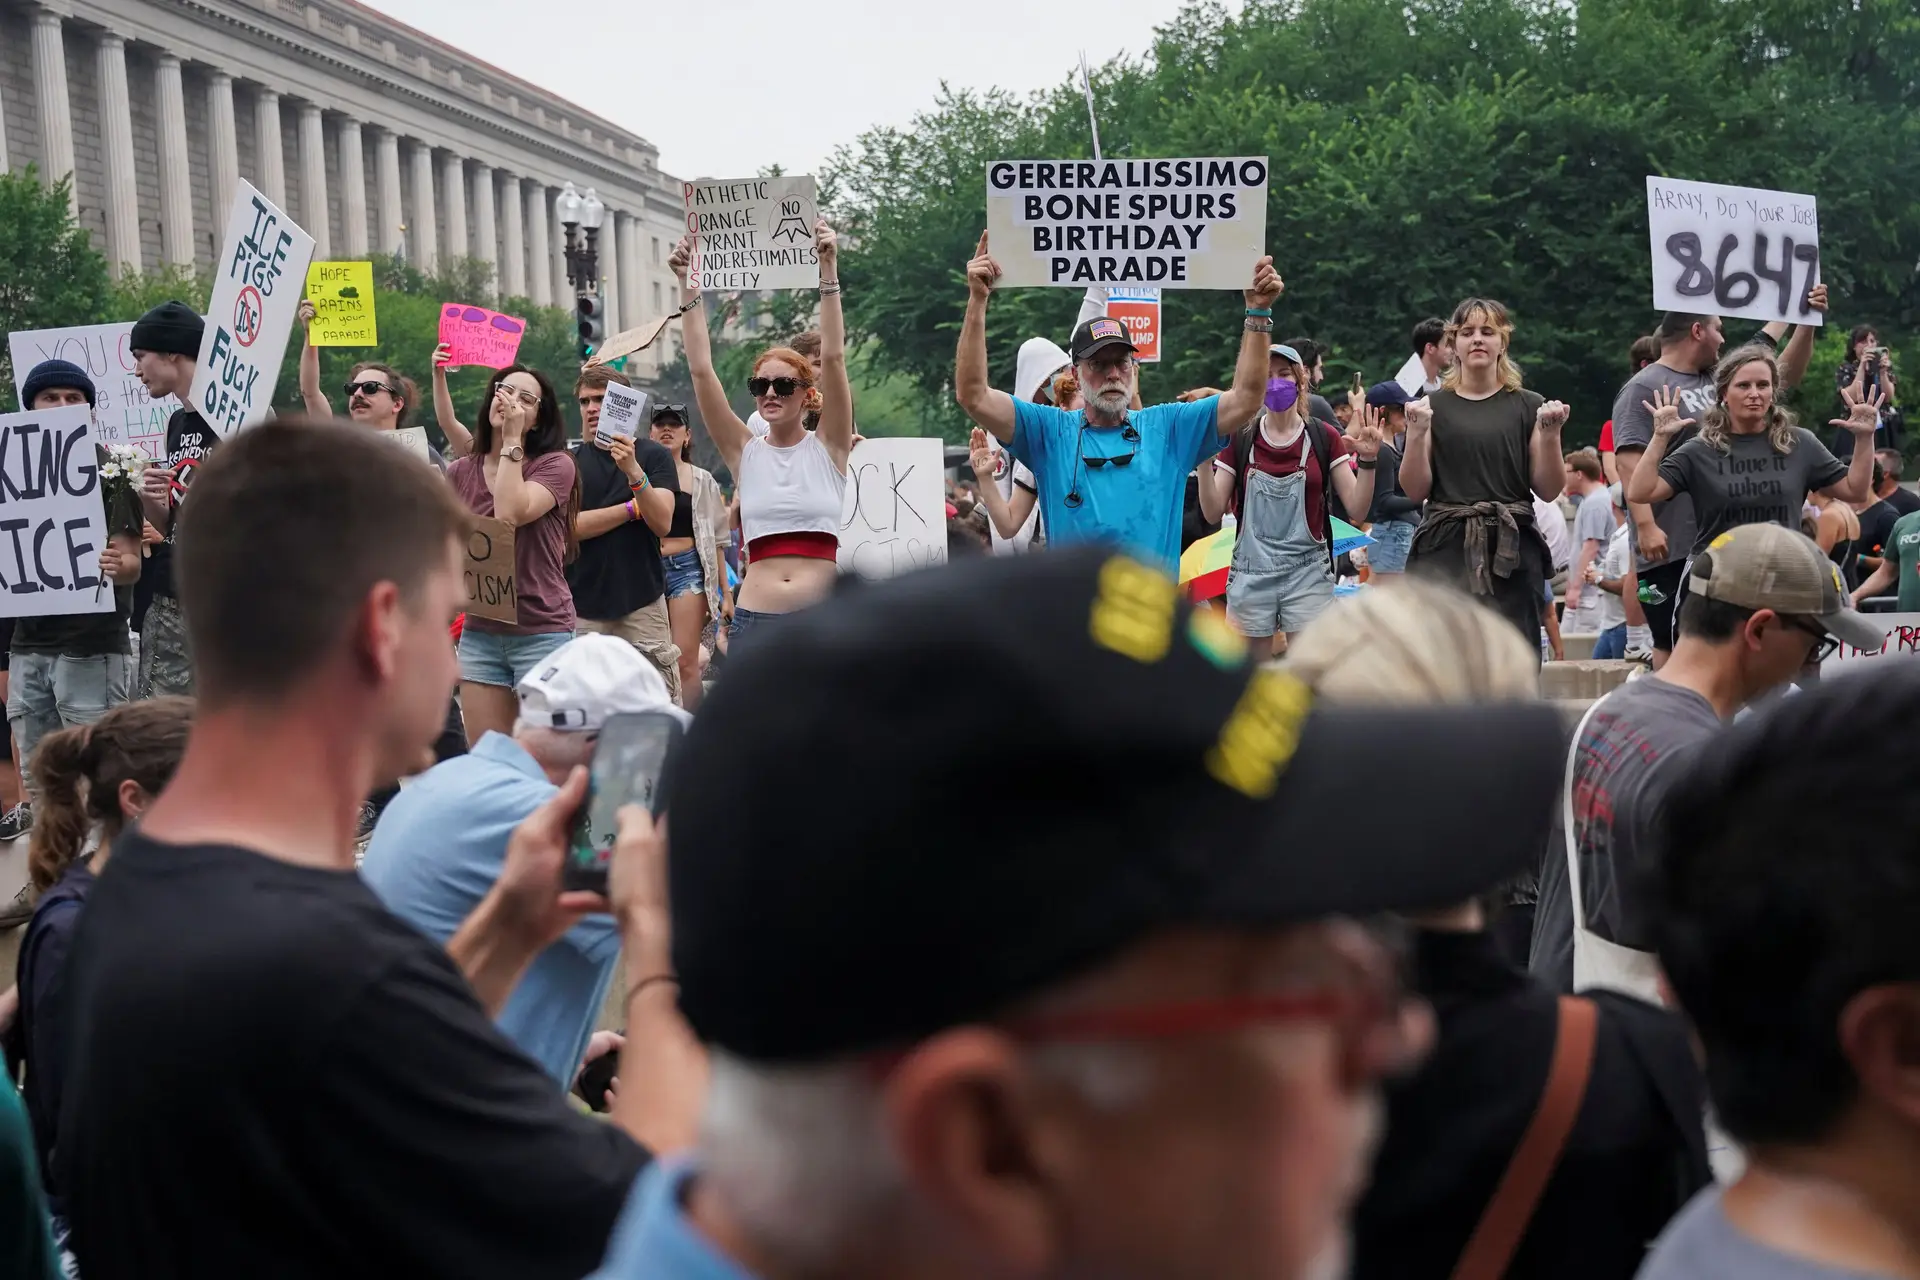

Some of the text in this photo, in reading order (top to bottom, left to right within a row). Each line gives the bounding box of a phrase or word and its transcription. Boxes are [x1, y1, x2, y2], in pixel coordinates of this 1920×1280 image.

[990, 160, 1267, 190] GERERALISSIMO
[684, 181, 769, 208] PATHETIC
[781, 200, 800, 216] NO
[1024, 193, 1236, 221] BONE SPURS
[1716, 196, 1738, 219] DO
[1747, 199, 1784, 223] YOUR
[1790, 203, 1817, 228] JOB!
[687, 207, 757, 233] ORANGE
[243, 195, 293, 277] ICE
[688, 230, 758, 253] TYRANT
[1033, 224, 1206, 251] BIRTHDAY
[691, 246, 818, 272] UNDERESTIMATES
[1052, 256, 1186, 282] PARADE
[320, 267, 351, 281] HOPE
[690, 271, 760, 289] SOCIETY
[1665, 231, 1819, 317] 8647
[310, 284, 324, 294] IT
[319, 298, 362, 312] RAINS
[234, 300, 258, 337] ICE
[338, 315, 366, 326] your
[1120, 316, 1151, 330] STOP
[323, 328, 373, 342] PARADE!
[1131, 333, 1154, 345] UMP
[35, 335, 108, 377] YOU
[208, 325, 260, 409] FUCK
[96, 419, 118, 440] the
[180, 432, 203, 448] DEAD
[168, 447, 213, 468] KENNEDYS
[1718, 454, 1787, 476] i love it
[1728, 476, 1783, 498] when
[463, 570, 516, 609] CISM
